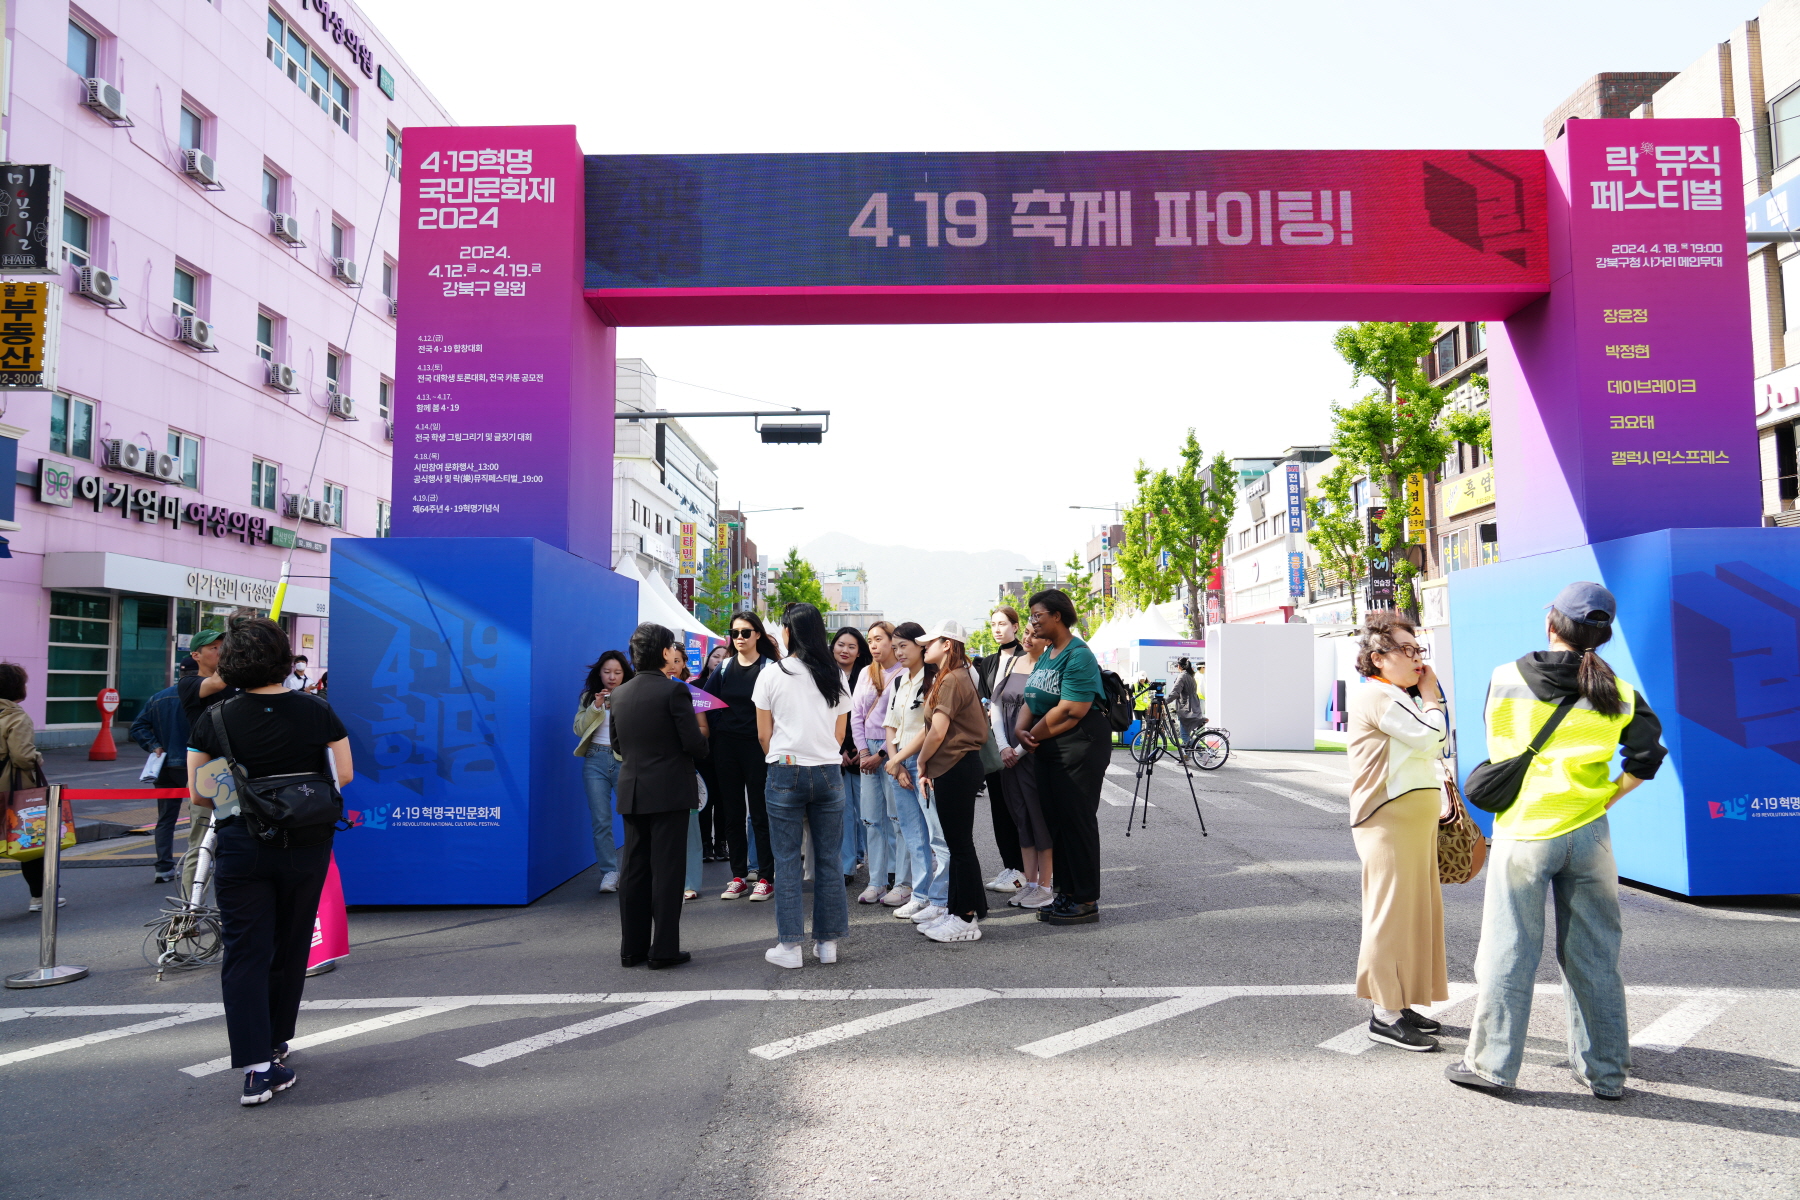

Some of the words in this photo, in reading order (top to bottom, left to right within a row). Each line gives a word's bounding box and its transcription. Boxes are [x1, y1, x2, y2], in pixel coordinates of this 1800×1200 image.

[420, 148, 532, 174] 4·19혁명
[419, 177, 555, 203] 국민문화제
[1590, 180, 1722, 211] 페스티벌
[418, 206, 499, 229] 2024
[849, 192, 988, 247] 4.19
[1011, 189, 1132, 247] 축제
[1154, 190, 1353, 246] 파이팅!
[459, 246, 511, 259] 2024.
[1690, 243, 1723, 253] 19:00
[2, 254, 37, 266] HAIR
[1595, 257, 1641, 269] 강북구청
[1642, 257, 1676, 268] 사거리
[1678, 257, 1723, 268] 메인무대
[4, 284, 37, 297] 골드
[442, 281, 490, 297] 강북구
[493, 281, 526, 297] 일원
[1603, 308, 1648, 324] 장윤정
[0, 299, 37, 369] 부동산
[417, 345, 433, 353] 전국
[453, 344, 483, 353] 합창대회
[1605, 344, 1650, 359] 박정현
[0, 373, 42, 384] 2-3000
[417, 374, 432, 383] 전국
[433, 374, 455, 383] 대학생
[489, 374, 504, 382] 전국
[521, 374, 544, 382] 공모전
[1607, 379, 1697, 394] 데이브레이크
[416, 404, 431, 412] 함께
[1610, 415, 1655, 430] 코요태
[415, 434, 430, 442] 전국
[431, 433, 446, 442] 학생
[447, 433, 484, 442] 그림그리기
[485, 433, 493, 441] 및
[494, 433, 516, 441] 글짓기
[517, 433, 532, 442] 대회
[1611, 450, 1730, 466] 갤럭시익스프레스
[414, 463, 443, 472] 시민참여
[413, 475, 443, 484] 공식행사
[444, 475, 452, 483] 및
[78, 476, 184, 530] 아가엄마
[186, 503, 266, 546] 여성의원
[412, 505, 444, 513] 제64주년
[682, 524, 694, 559] 비타민
[188, 573, 238, 601] 아가엄마
[1374, 579, 1390, 587] 연습장
[422, 806, 501, 820] 혁명국민문화제
